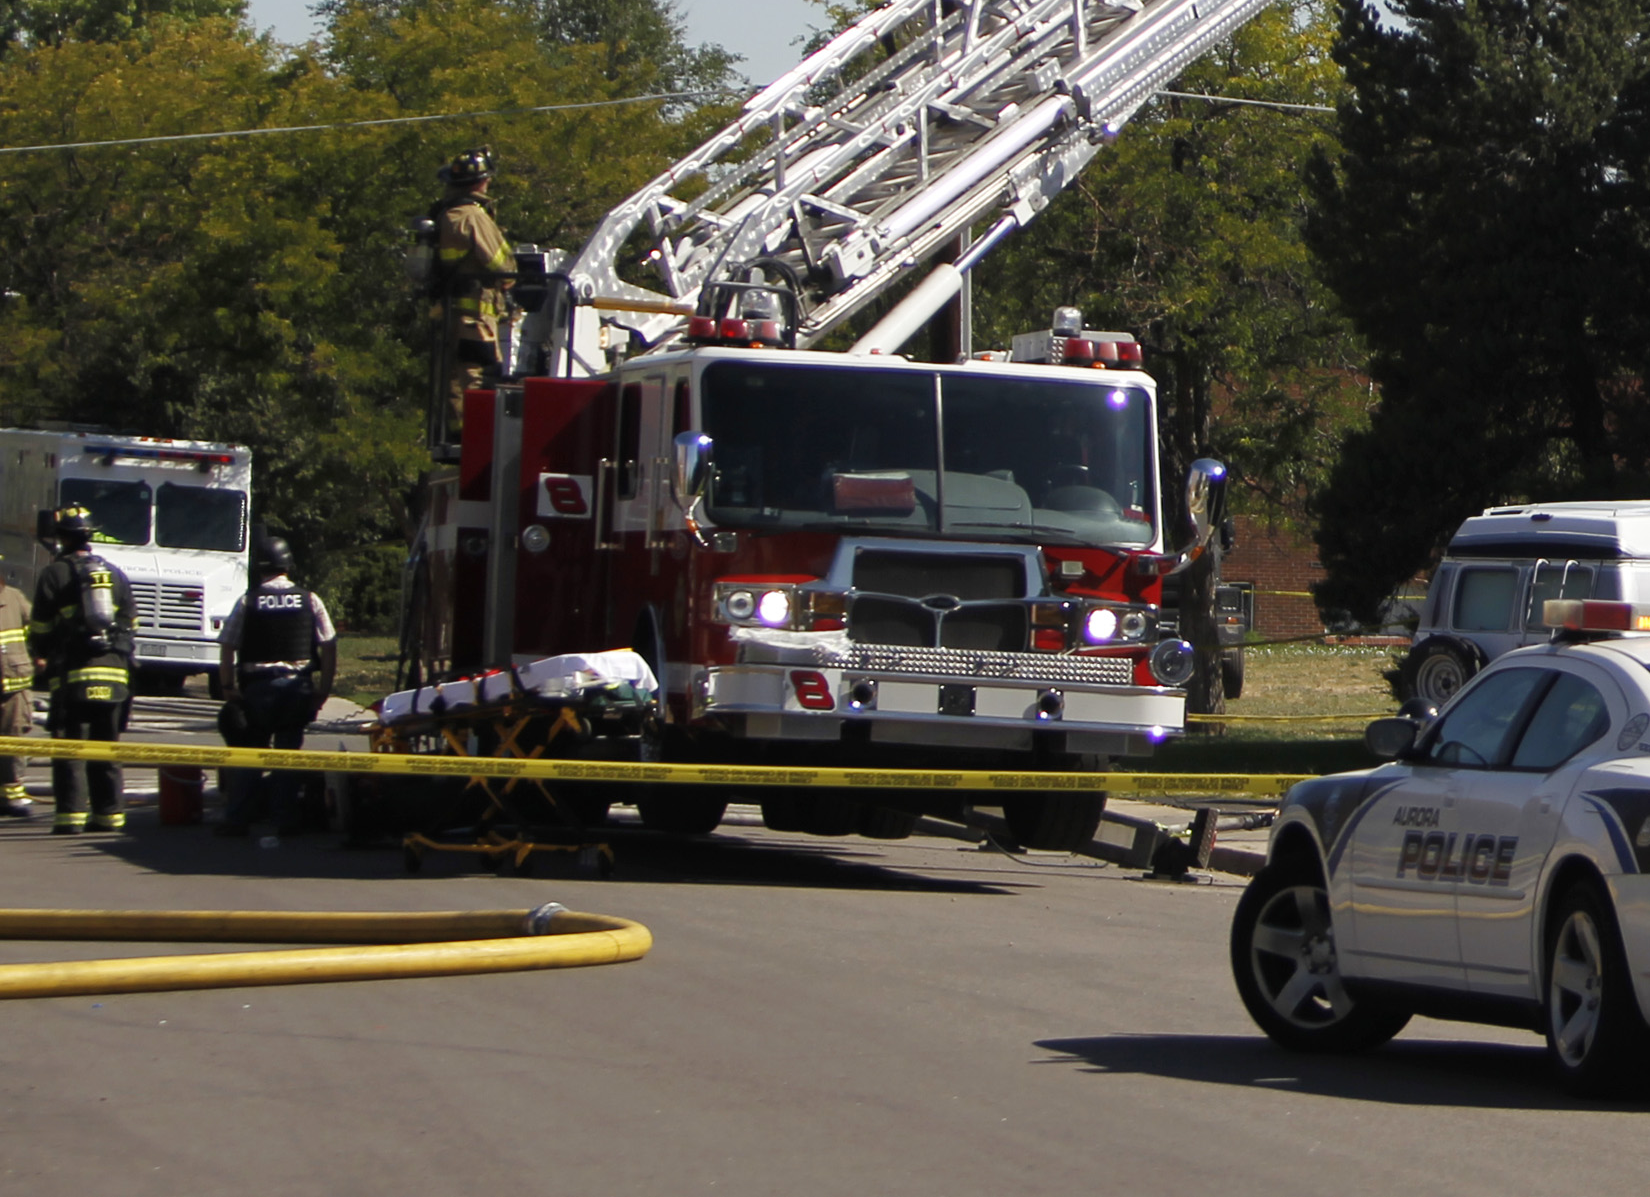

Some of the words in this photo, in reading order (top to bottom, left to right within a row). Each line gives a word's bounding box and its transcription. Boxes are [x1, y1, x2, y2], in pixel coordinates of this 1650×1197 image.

[545, 476, 588, 515] 8
[257, 594, 302, 609] POLICE
[789, 670, 836, 711] 8
[1392, 806, 1440, 827] AURORA
[1396, 829, 1520, 887] POLICE
